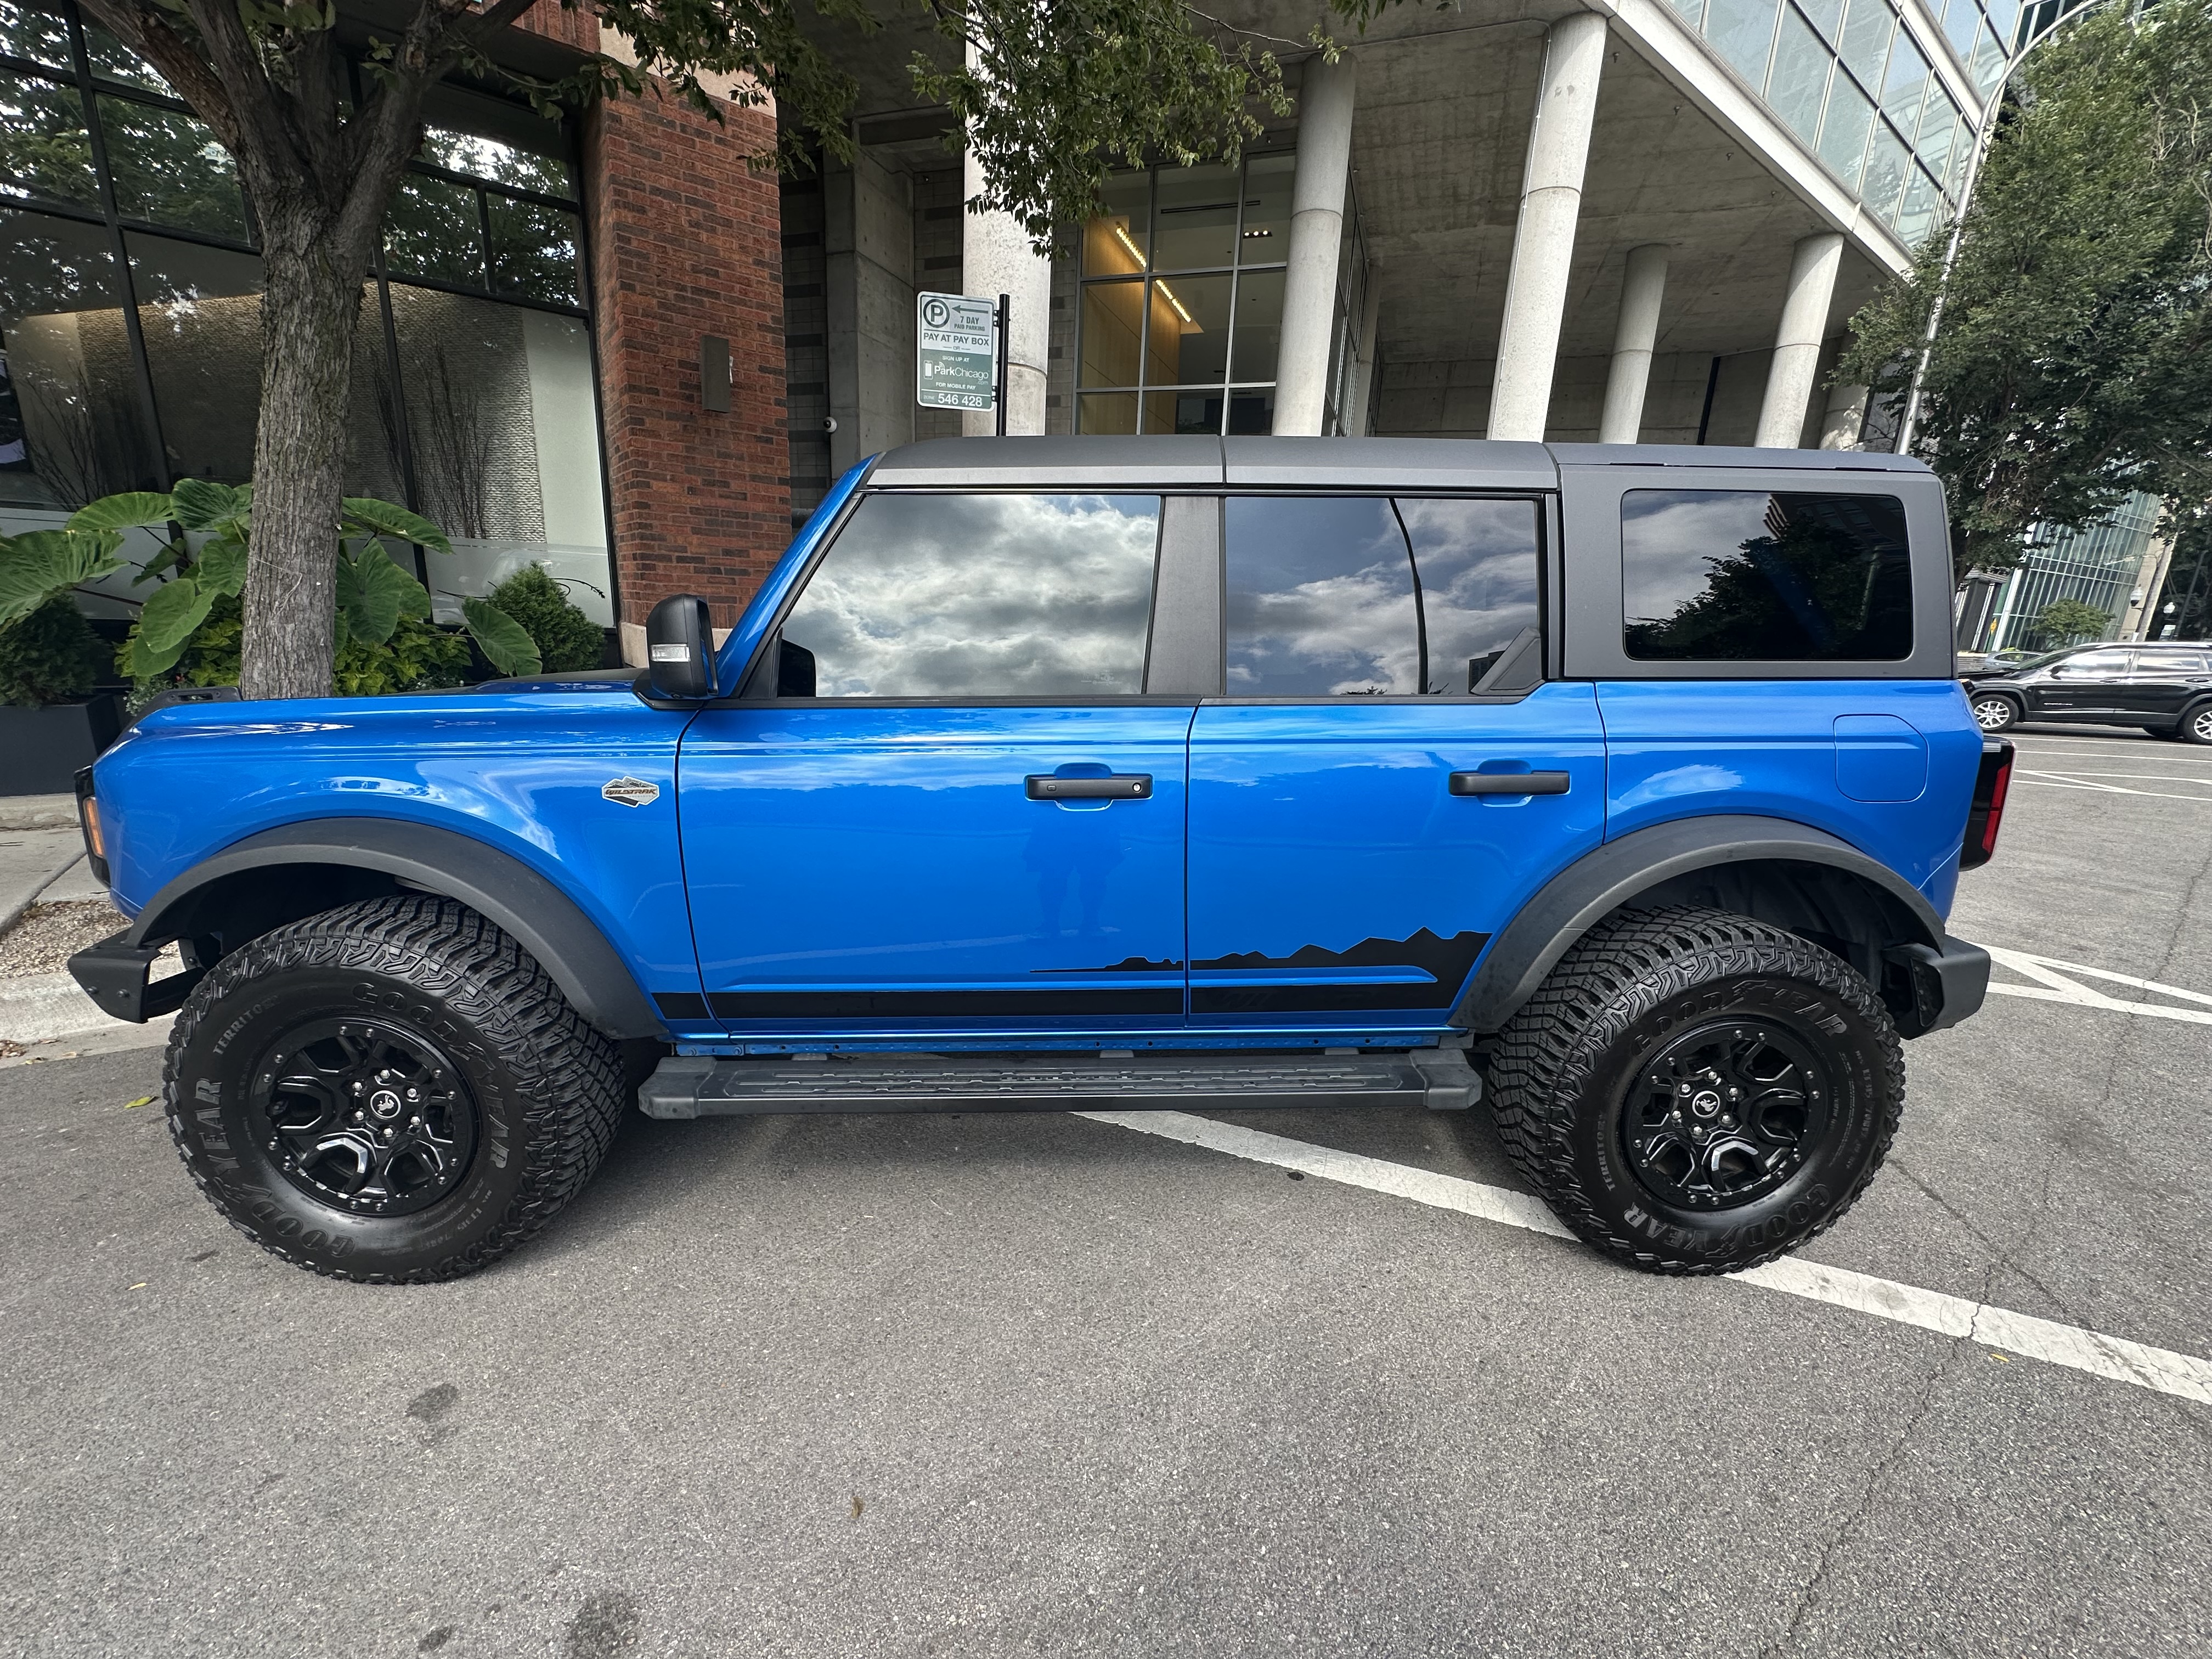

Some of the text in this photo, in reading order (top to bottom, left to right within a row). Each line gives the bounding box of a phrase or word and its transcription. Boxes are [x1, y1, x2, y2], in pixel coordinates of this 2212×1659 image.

[931, 304, 944, 322] P
[966, 317, 979, 325] DAY
[924, 332, 939, 341] PAY
[953, 336, 969, 344] PAY
[972, 337, 989, 346] BOX
[934, 365, 989, 381] ParkChicago
[938, 393, 958, 405] 546
[961, 395, 983, 407] 428
[195, 1078, 356, 1259] GOODYEAR
[1623, 1183, 1831, 1258] GOODYEAR
